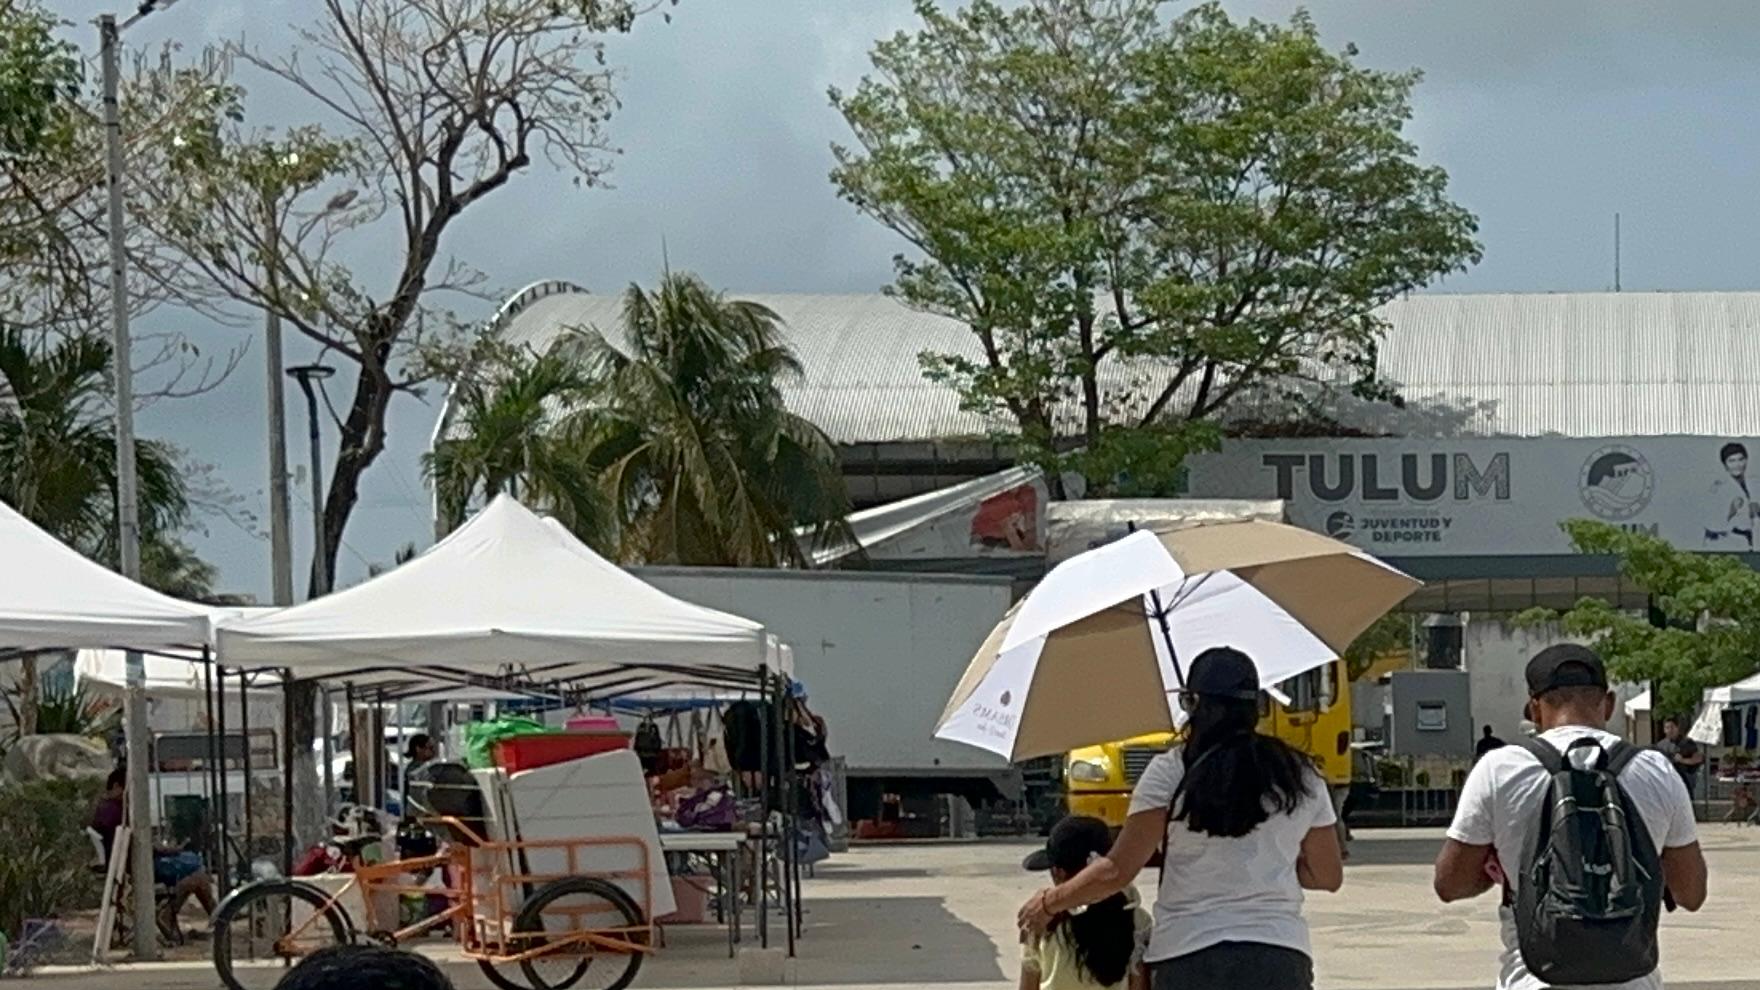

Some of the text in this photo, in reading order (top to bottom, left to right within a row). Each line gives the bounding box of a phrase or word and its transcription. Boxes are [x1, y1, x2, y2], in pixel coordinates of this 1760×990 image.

[1262, 452, 1510, 501] TULUM
[1361, 518, 1453, 530] JUVENTUD Y
[1372, 531, 1442, 542] DEPORTE
